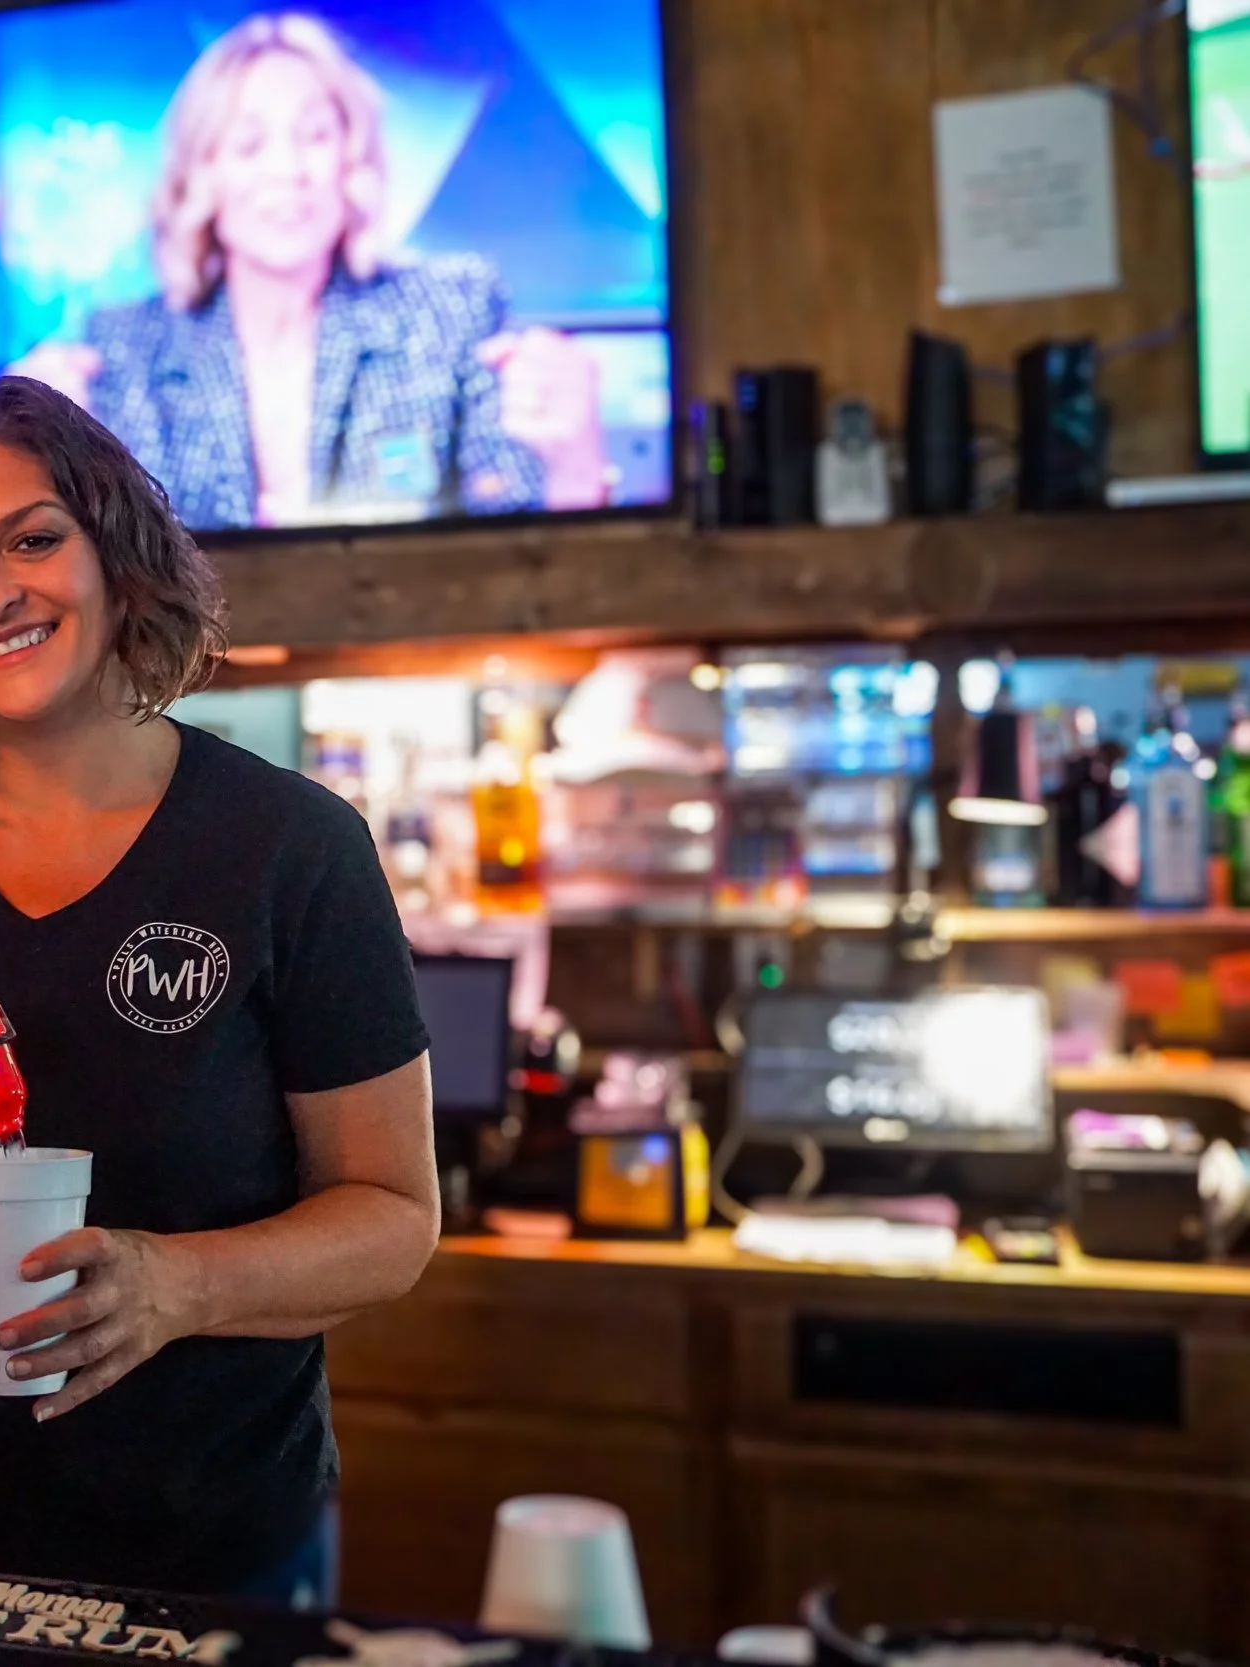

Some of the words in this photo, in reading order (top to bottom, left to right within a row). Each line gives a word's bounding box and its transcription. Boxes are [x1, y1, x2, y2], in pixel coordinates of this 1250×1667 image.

[112, 942, 134, 971] PALS
[138, 926, 203, 942] WATERING
[208, 941, 227, 966] HOLE
[126, 952, 210, 1002] PWH
[127, 1009, 155, 1029] LAKE
